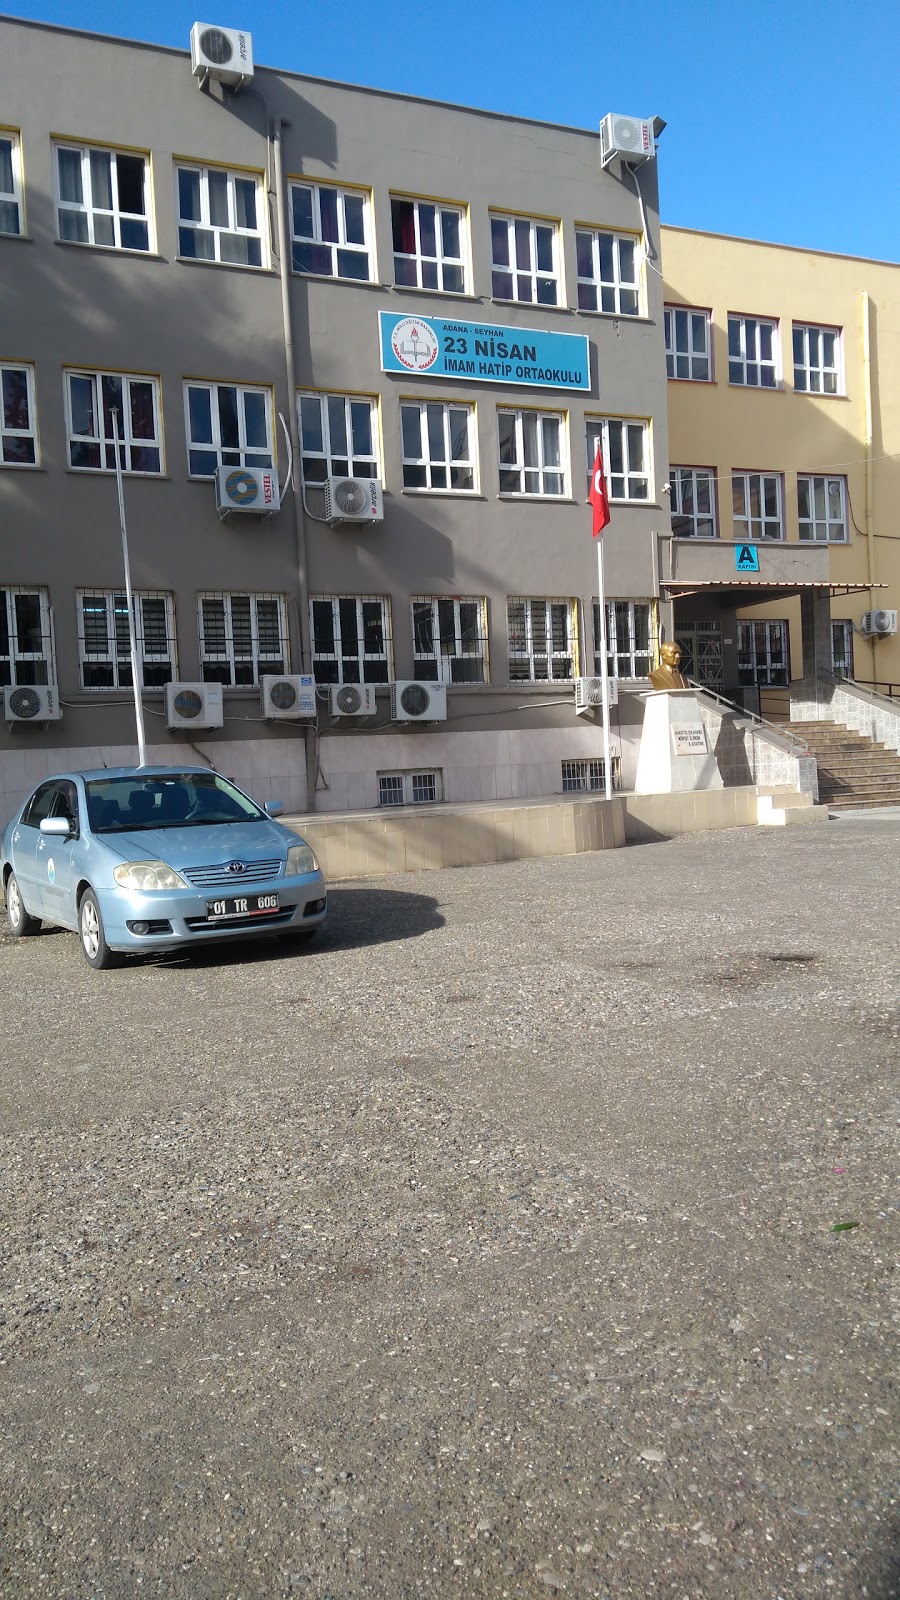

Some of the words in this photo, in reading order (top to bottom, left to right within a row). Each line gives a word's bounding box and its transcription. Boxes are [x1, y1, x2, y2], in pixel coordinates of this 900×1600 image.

[238, 34, 247, 60] arçelik
[442, 324, 468, 334] ADANA
[474, 328, 504, 338] SEYHAN
[443, 336, 468, 354] 23
[474, 337, 537, 362] NİSAN
[444, 355, 475, 372] İMAM
[479, 361, 512, 377] HATİP
[515, 365, 582, 384] ORTAOKULU
[263, 474, 272, 504] VESTEL
[738, 546, 755, 564] A
[213, 900, 226, 914] 01
[233, 898, 248, 913] TR
[257, 894, 277, 909] 606
